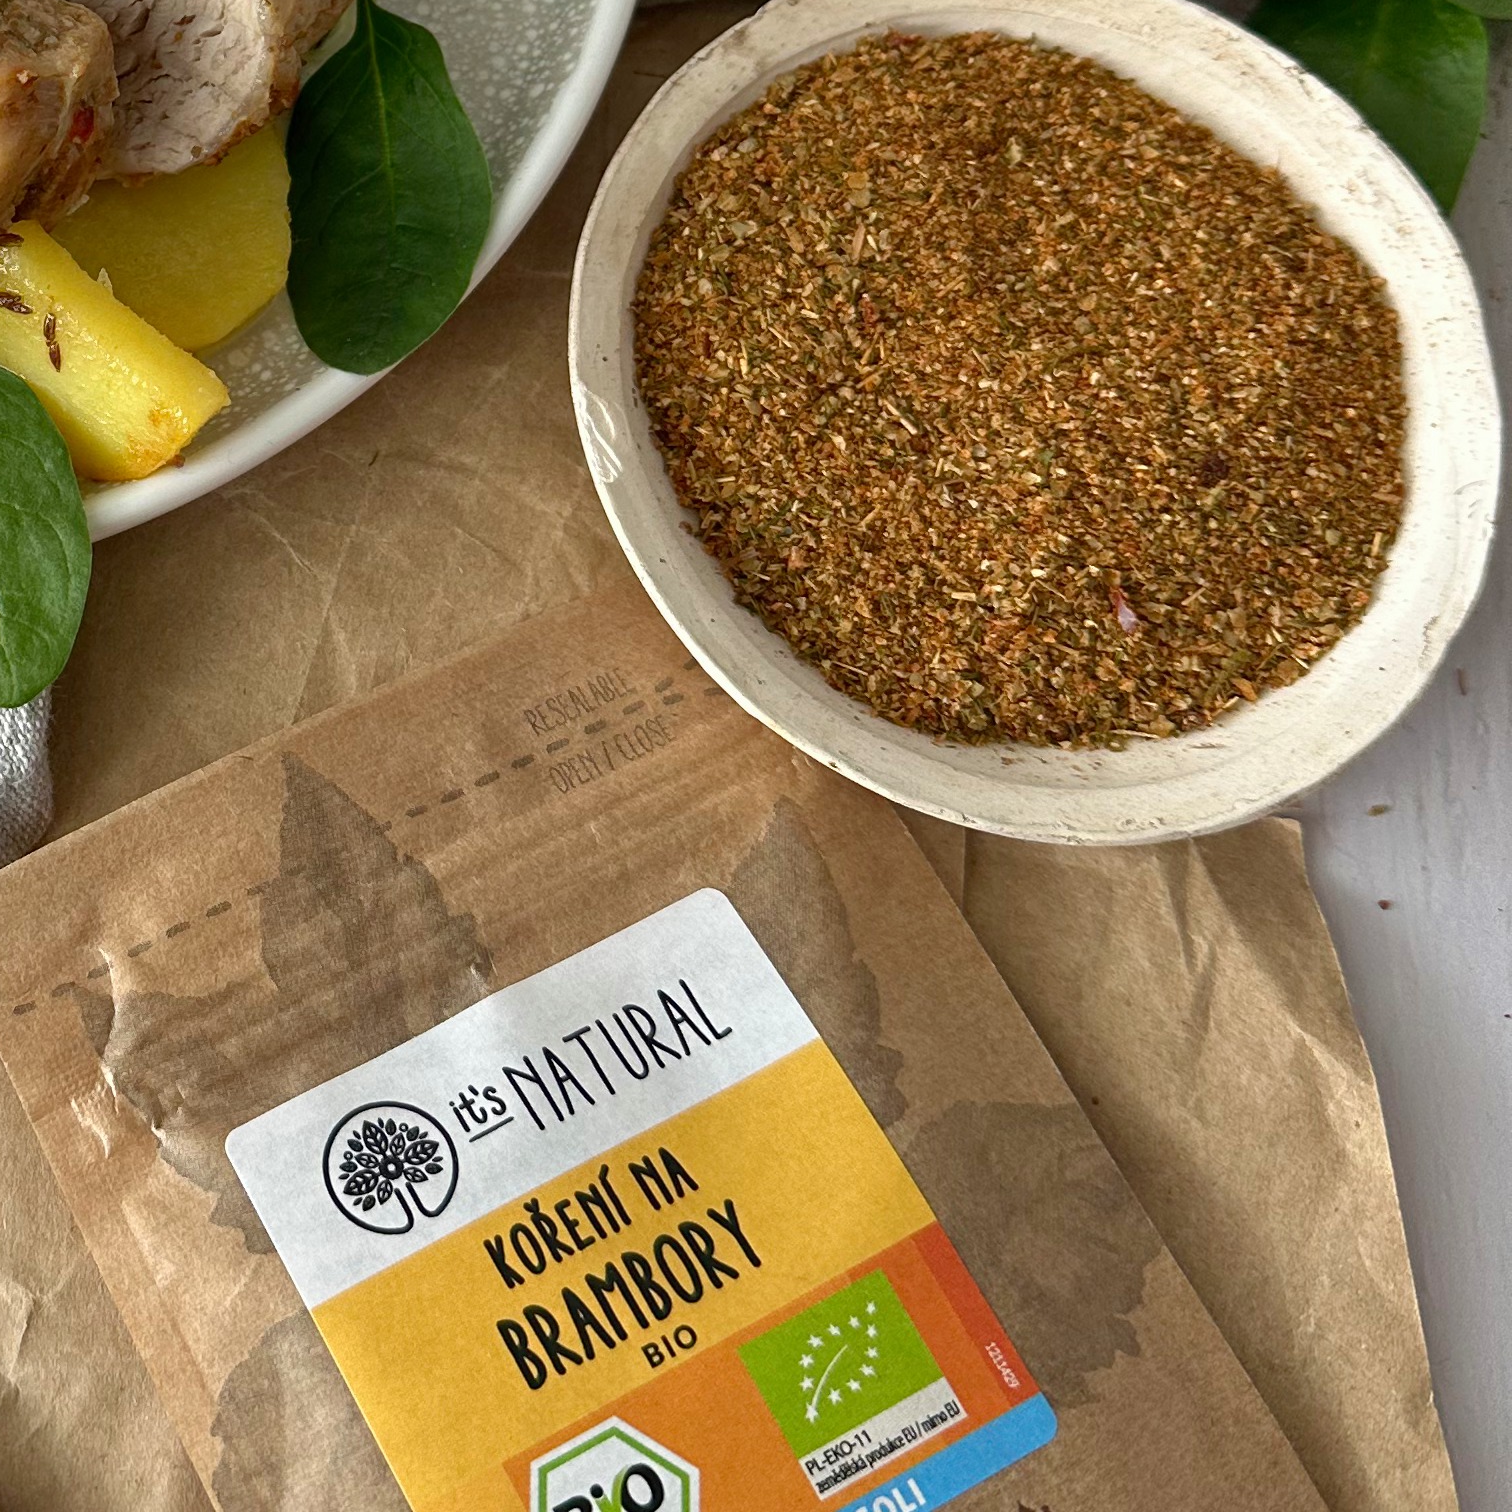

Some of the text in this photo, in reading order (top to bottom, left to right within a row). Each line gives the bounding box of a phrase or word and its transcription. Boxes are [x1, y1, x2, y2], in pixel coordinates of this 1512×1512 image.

[524, 667, 632, 737] RESEALABLE
[547, 715, 677, 794] OPEN / CLOSE
[449, 978, 733, 1133] it's NATURAL
[483, 1146, 700, 1289] KOŘENÍ NA
[496, 1198, 762, 1390] BRAMBORY
[641, 1324, 698, 1369] BIO
[805, 1429, 872, 1476] PL-EKO-11
[901, 1424, 918, 1444] EU
[944, 1399, 962, 1419] EU
[854, 1478, 926, 1512] OLI
